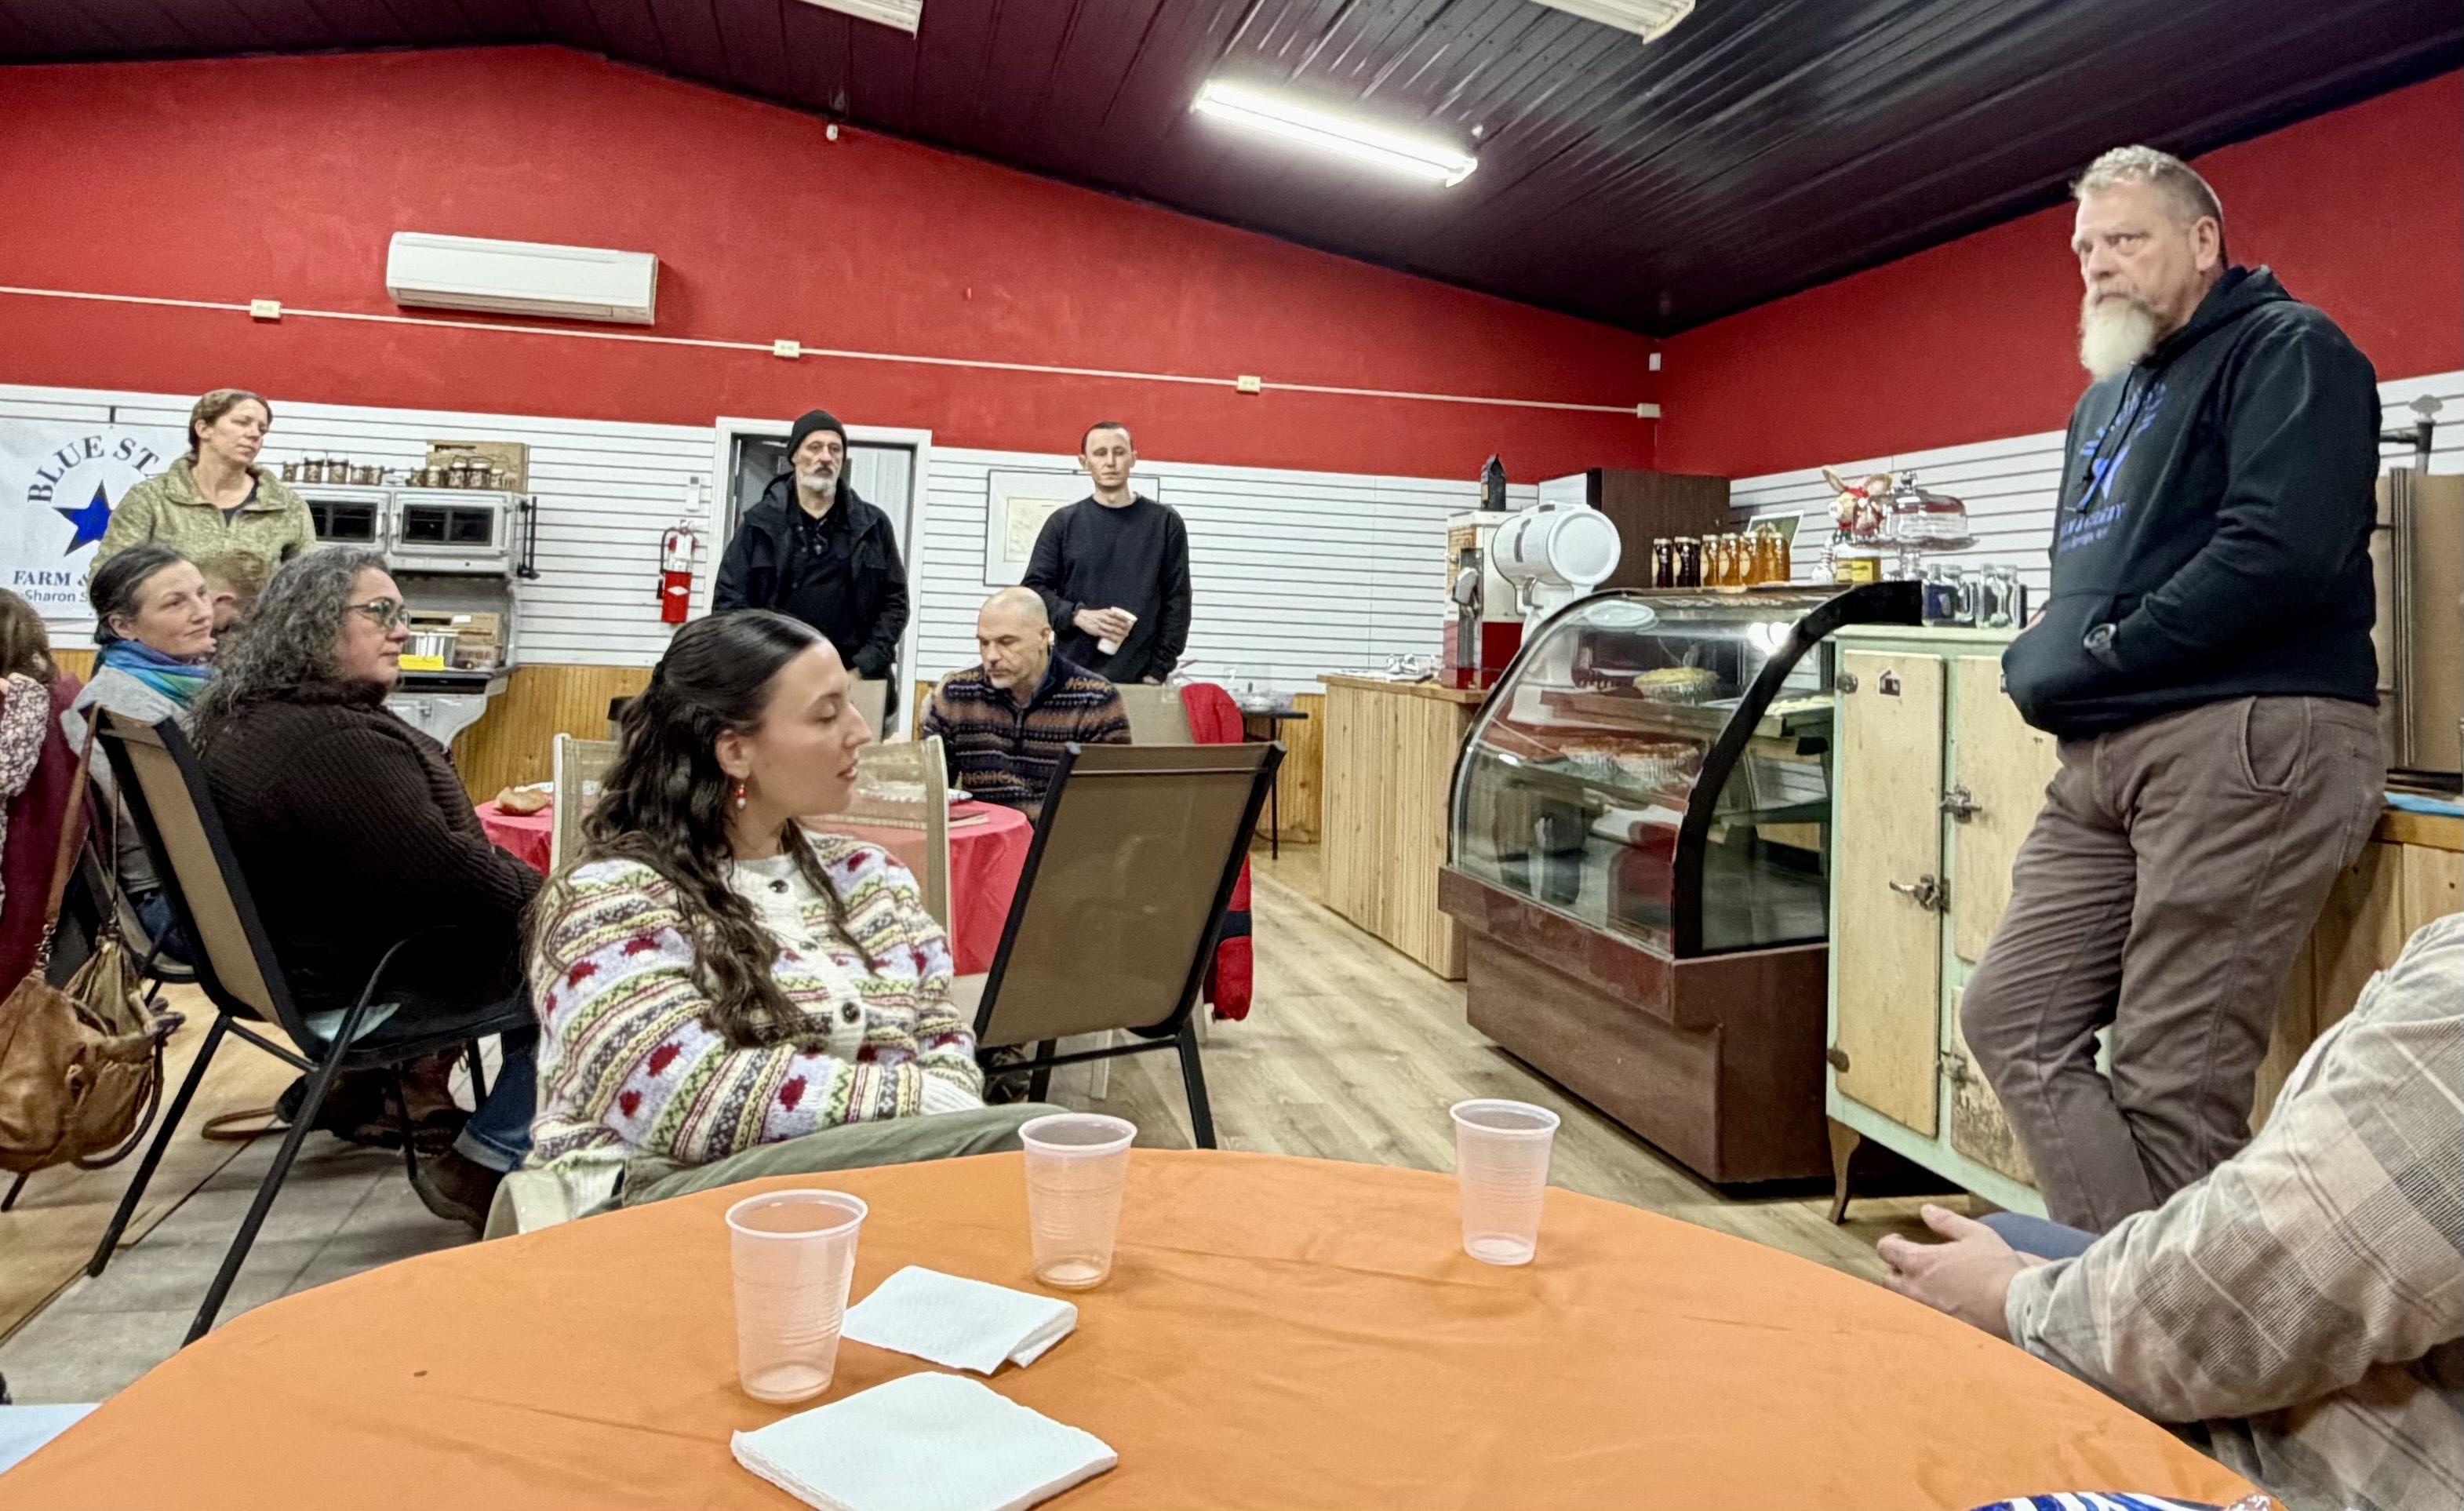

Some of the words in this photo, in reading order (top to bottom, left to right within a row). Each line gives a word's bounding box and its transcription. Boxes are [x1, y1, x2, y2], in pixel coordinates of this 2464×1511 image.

[27, 435, 104, 503] BLUE
[112, 437, 160, 475] ST
[13, 570, 71, 586] FARM
[24, 589, 76, 603] Sharon
[79, 592, 89, 603] S
